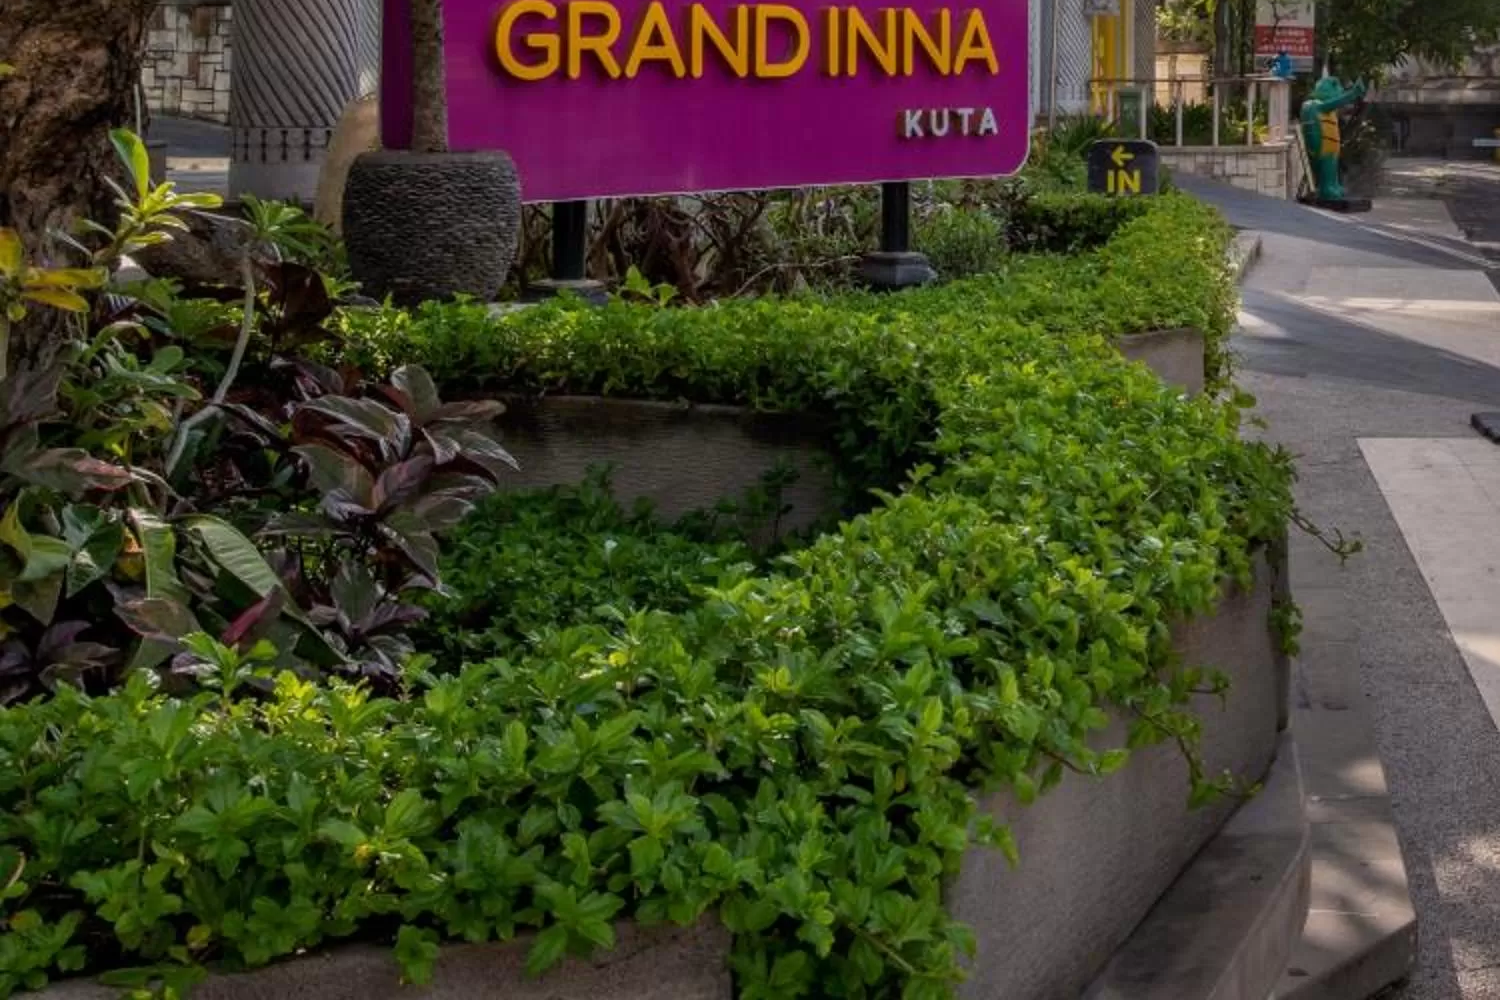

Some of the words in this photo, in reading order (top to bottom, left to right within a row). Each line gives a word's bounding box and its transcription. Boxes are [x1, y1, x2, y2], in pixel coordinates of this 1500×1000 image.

[828, 5, 999, 77] INNA
[904, 107, 999, 139] KUTA
[1107, 168, 1141, 196] IN
